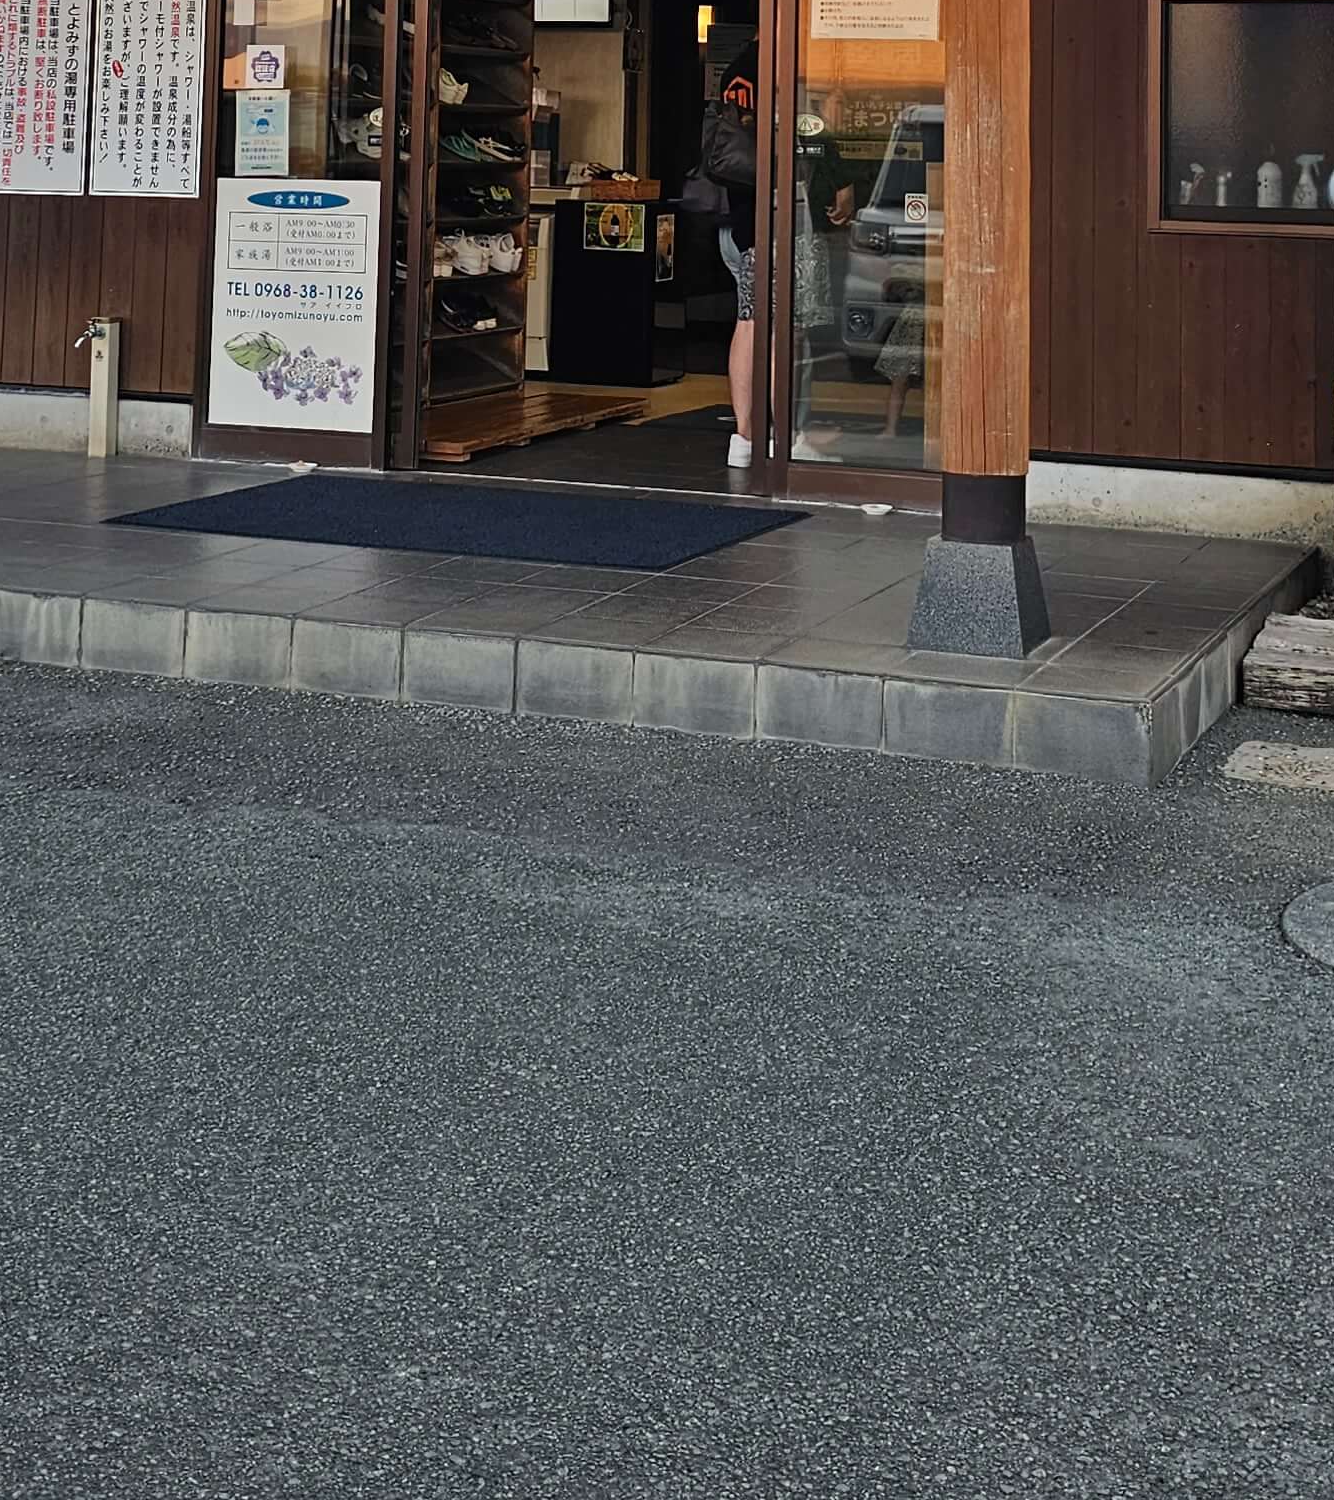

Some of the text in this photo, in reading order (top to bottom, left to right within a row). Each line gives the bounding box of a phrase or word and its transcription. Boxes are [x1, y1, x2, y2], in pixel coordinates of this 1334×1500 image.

[274, 194, 322, 206] 営業時間
[227, 281, 364, 300] TEL 0968-38-1126
[226, 307, 364, 323] http://toyomizunoyu.com
